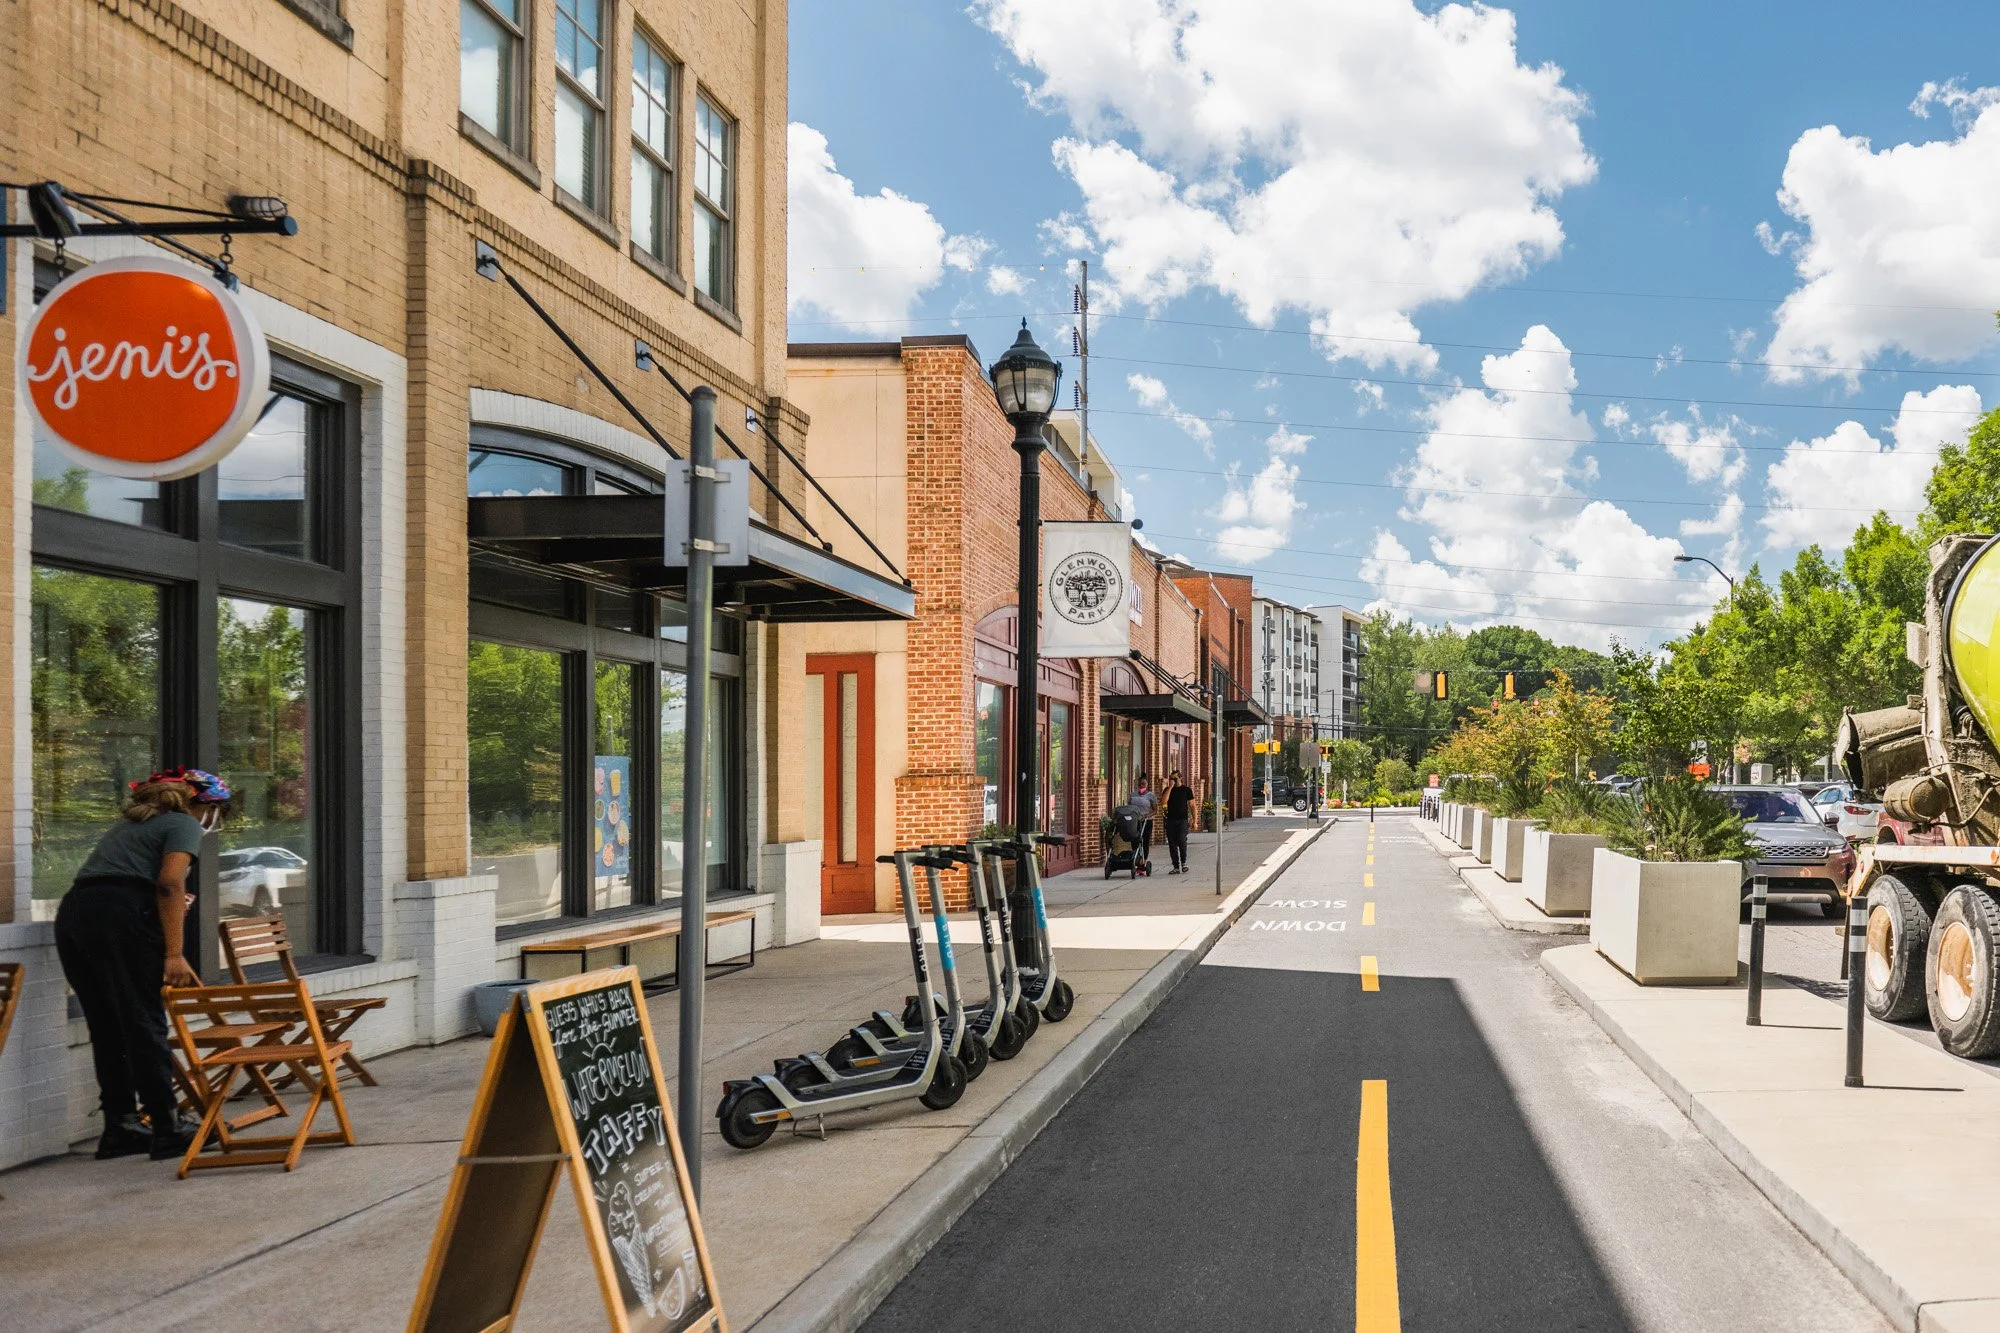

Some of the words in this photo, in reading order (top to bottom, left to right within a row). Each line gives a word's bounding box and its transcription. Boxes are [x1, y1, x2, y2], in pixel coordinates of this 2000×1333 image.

[27, 326, 237, 410] jeni's
[1055, 558, 1116, 587] GLENWOOD
[1068, 607, 1107, 619] PARK
[1001, 905, 1012, 935] BIRD
[1267, 899, 1348, 909] SLOW
[941, 923, 953, 959] BIRD
[983, 913, 995, 945] BIRD
[1249, 920, 1347, 932] DOWN
[915, 937, 929, 973] BIRD
[544, 1001, 579, 1032] GUESS
[577, 992, 606, 1019] WHO'S
[607, 986, 634, 1011] BACK
[552, 1028, 578, 1060] for
[578, 1017, 602, 1040] the
[602, 1006, 640, 1034] SUMMER
[561, 1037, 651, 1121] WATERMELON
[581, 1102, 666, 1175] TAFFY
